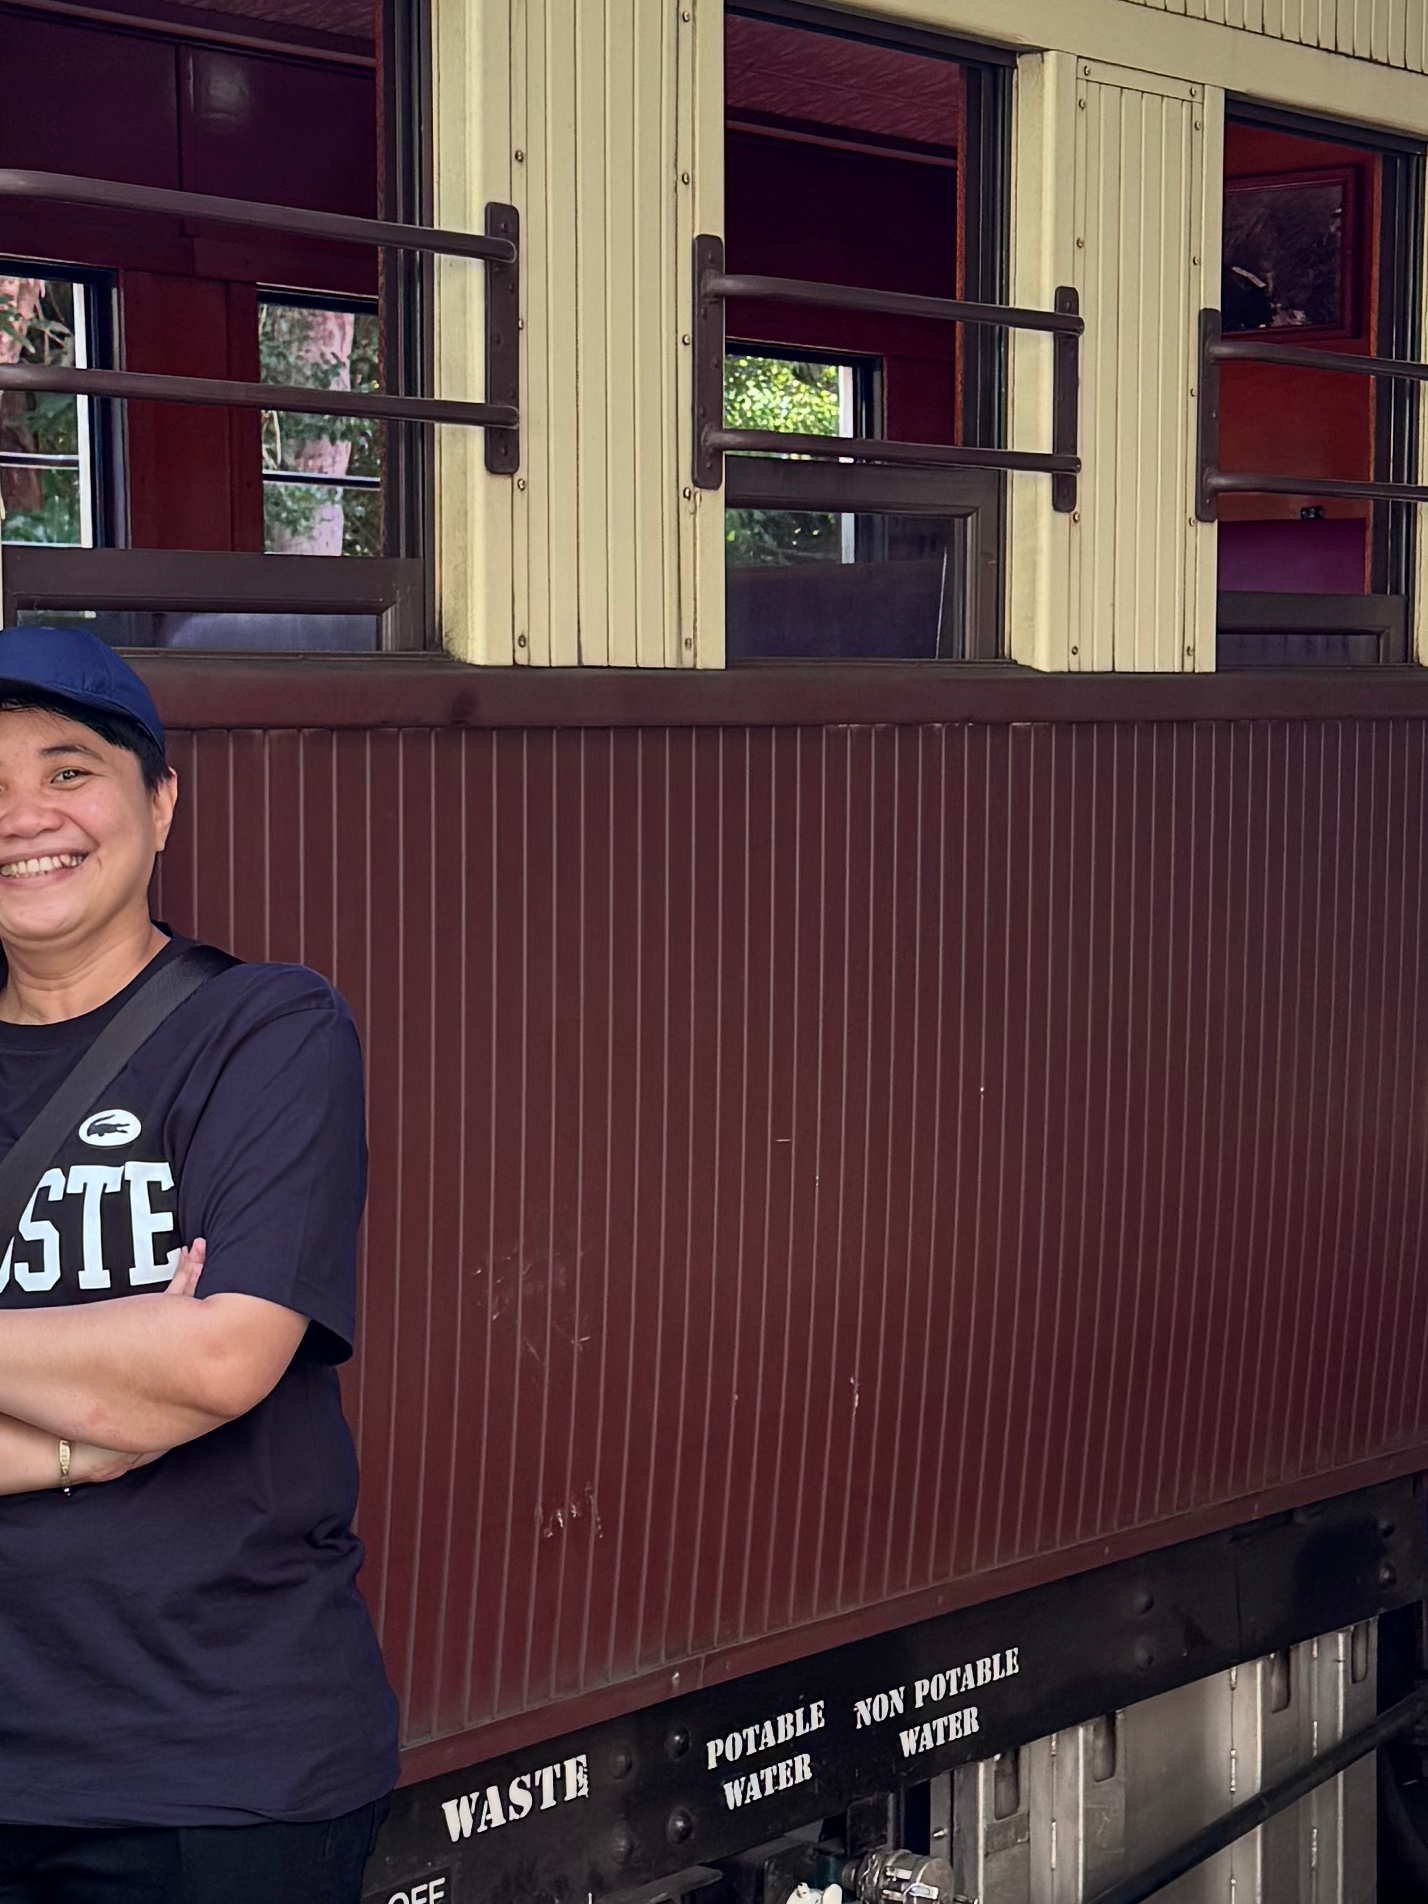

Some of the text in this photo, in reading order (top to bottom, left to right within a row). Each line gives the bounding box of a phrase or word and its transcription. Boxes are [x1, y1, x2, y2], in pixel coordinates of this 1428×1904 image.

[855, 1647, 1019, 1729] NON POTABLE
[706, 1700, 825, 1770] POTABLE
[899, 1706, 980, 1758] WATER
[441, 1754, 590, 1843] WASTE
[722, 1753, 813, 1811] WATER
